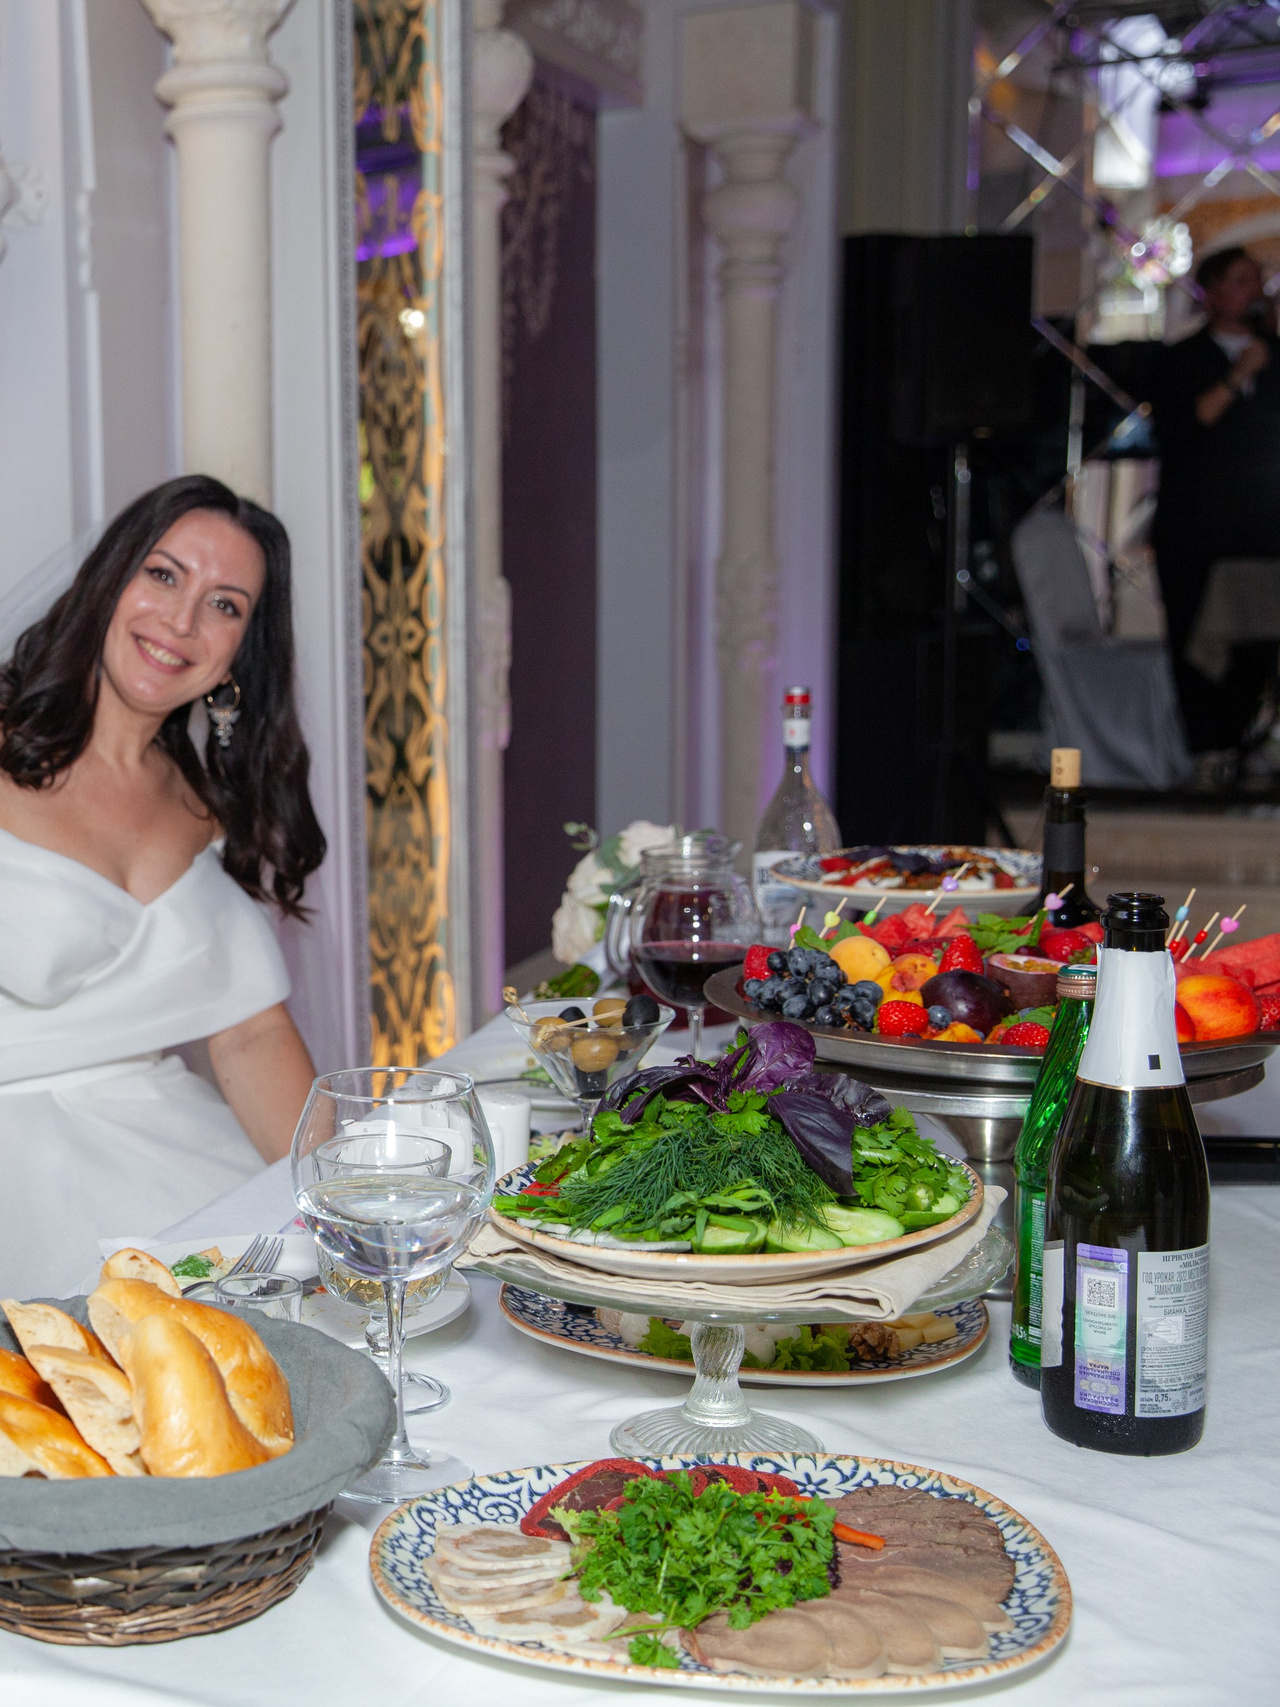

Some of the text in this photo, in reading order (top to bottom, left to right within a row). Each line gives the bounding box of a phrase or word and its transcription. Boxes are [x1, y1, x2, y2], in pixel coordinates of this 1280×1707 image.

[1162, 1252, 1194, 1262] ИГРИСТОЕ
[1088, 1362, 1109, 1370] МАРКА
[1079, 1392, 1119, 1403] ФЕДЕРАЦИЯ
[1079, 1396, 1119, 1408] РОССИЙСКАЯ
[1154, 1394, 1169, 1403] 0,75
